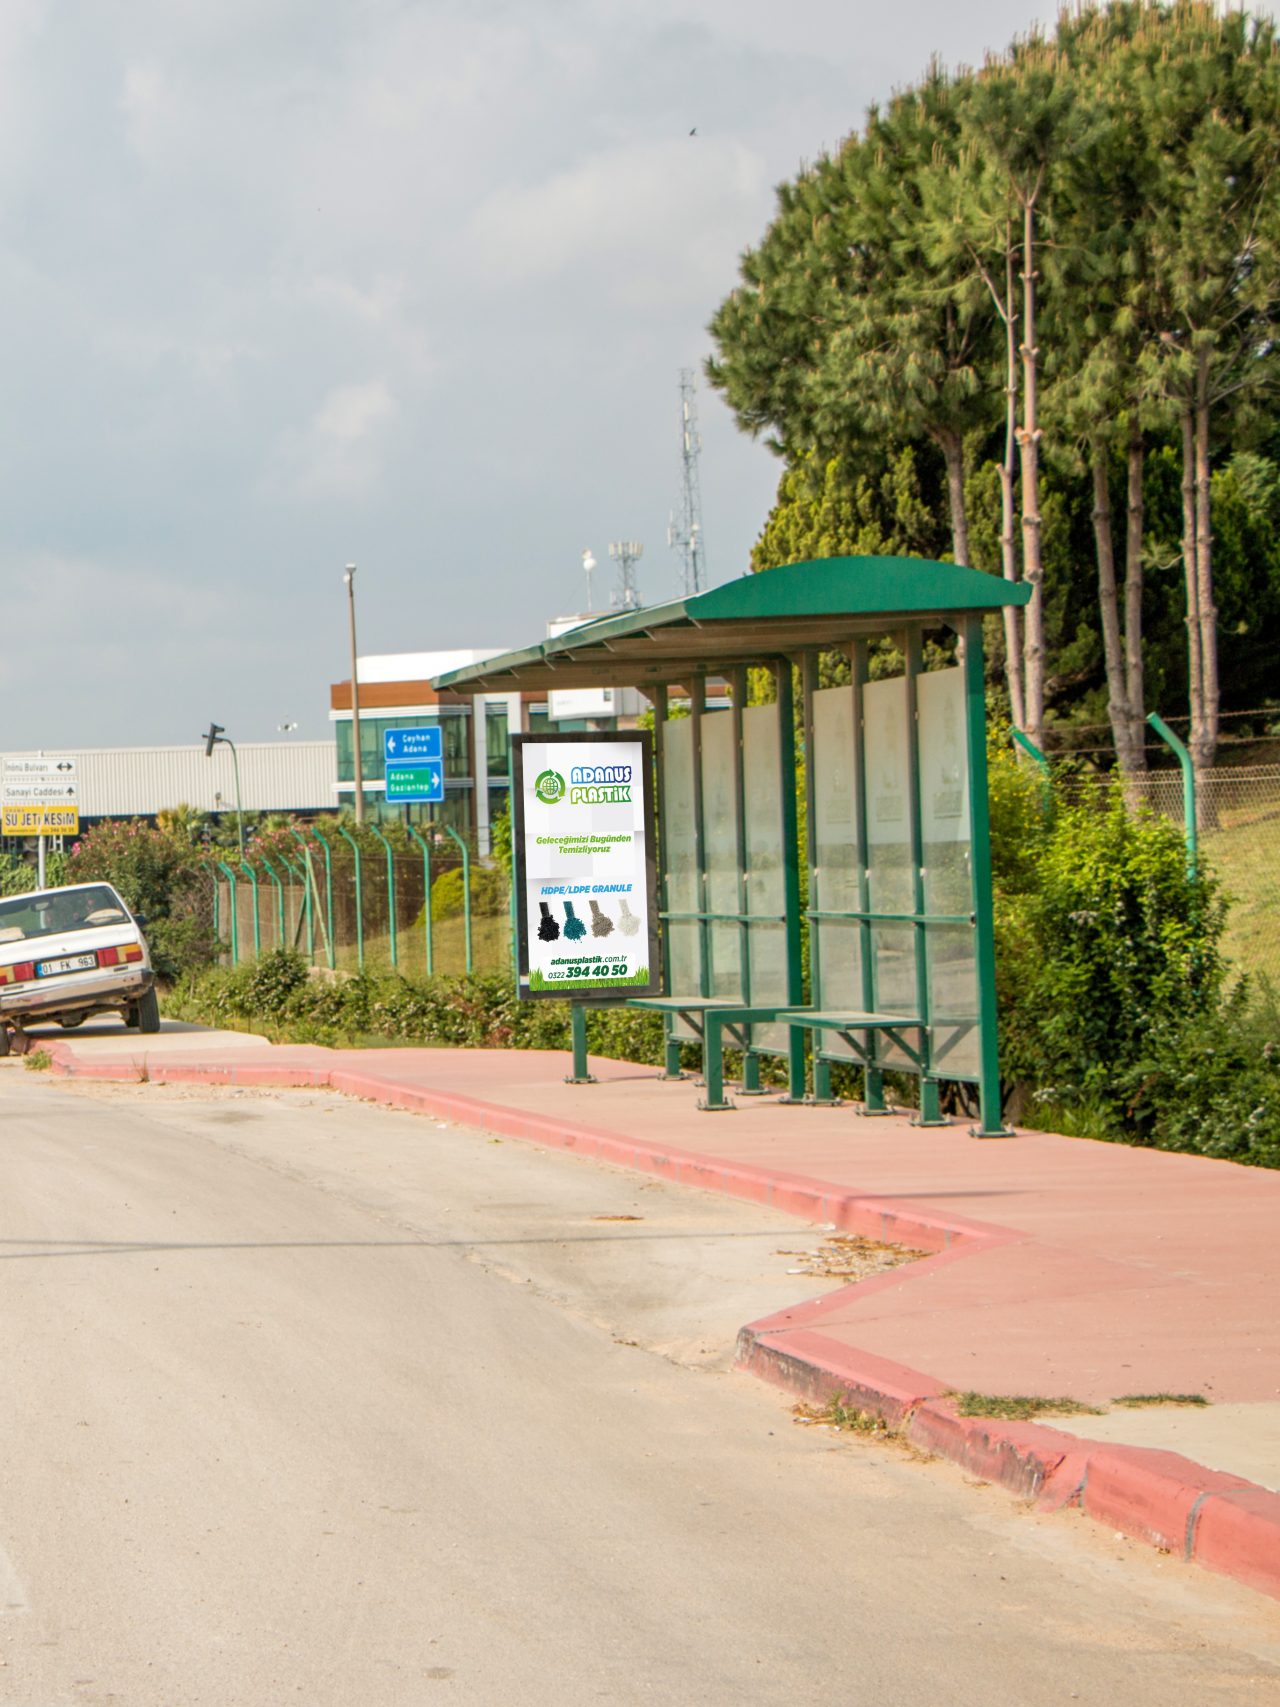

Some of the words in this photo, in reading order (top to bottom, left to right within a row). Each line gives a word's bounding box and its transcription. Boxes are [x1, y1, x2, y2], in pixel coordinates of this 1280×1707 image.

[403, 745, 428, 753] Adana
[390, 773, 414, 781] Adana
[571, 766, 632, 784] ADANUS
[6, 787, 32, 797] Sanayi
[33, 787, 64, 796] Caddesi
[390, 784, 429, 792] Gaziantep
[5, 813, 18, 826] SU
[590, 834, 632, 843] Bugünden
[559, 845, 611, 855] Temizliyoruz
[541, 885, 591, 895] HDPE/LDPE
[591, 884, 633, 893] GRANULE
[42, 963, 53, 974] 01
[548, 972, 565, 980] 0322
[566, 966, 591, 978] 394
[592, 966, 609, 977] 40
[611, 964, 628, 976] 50
